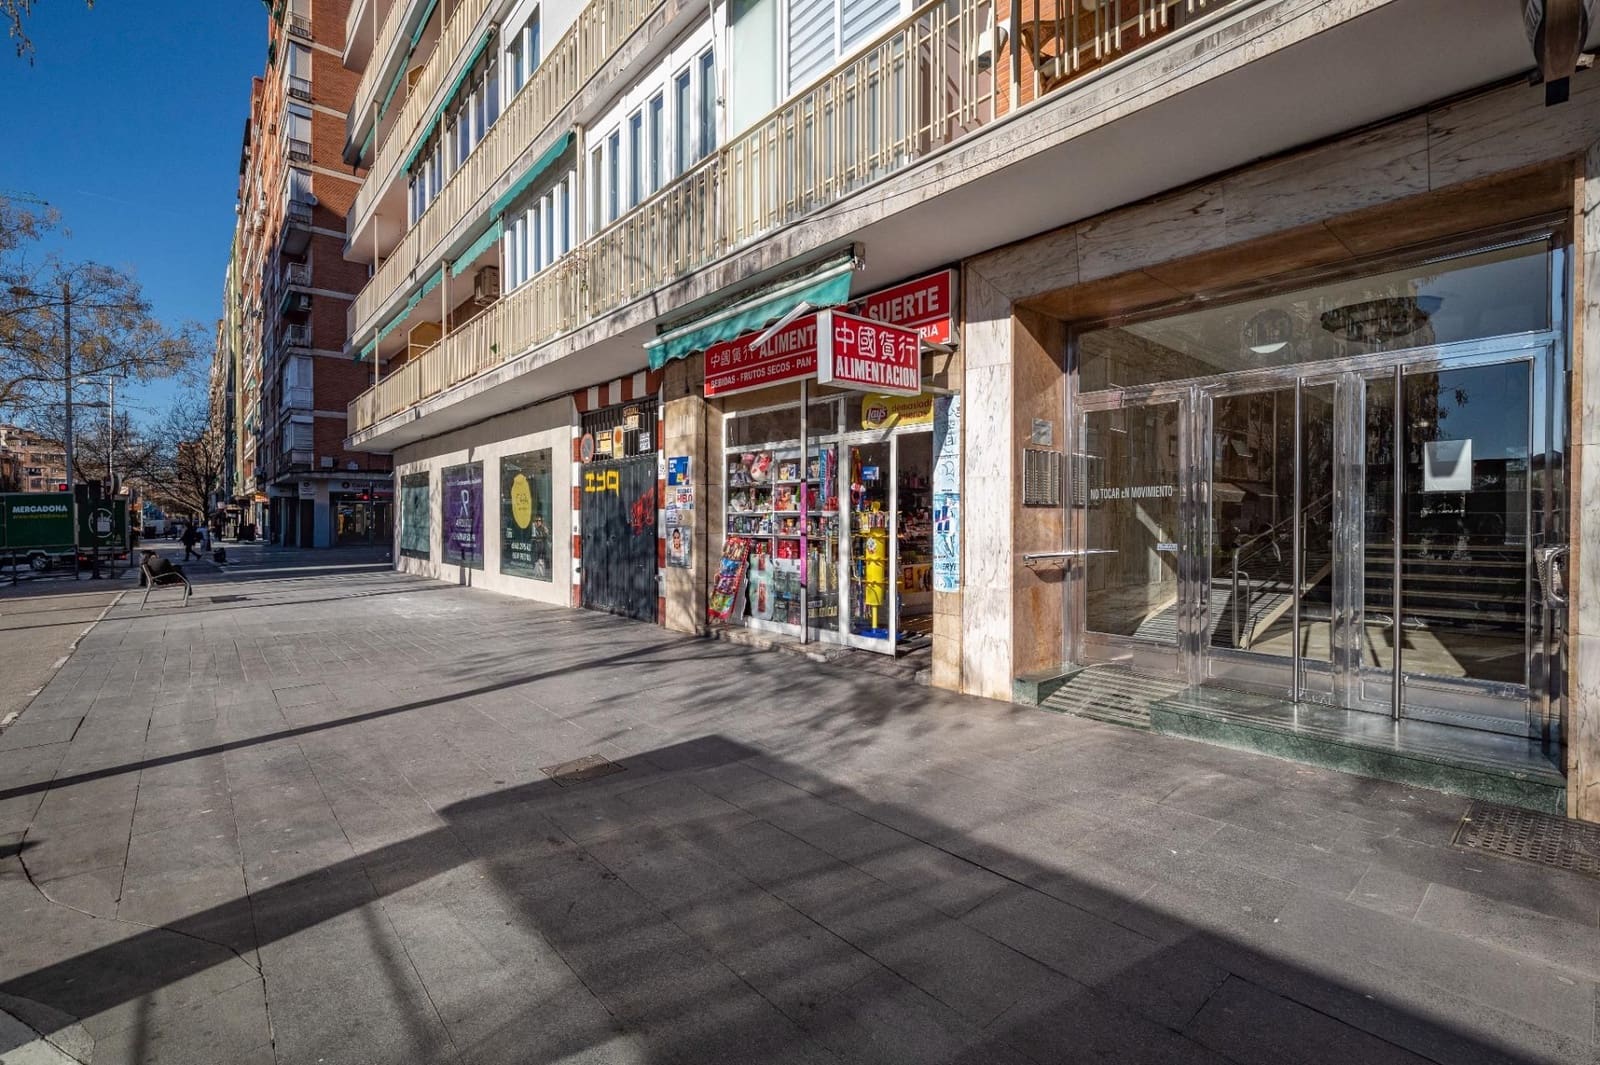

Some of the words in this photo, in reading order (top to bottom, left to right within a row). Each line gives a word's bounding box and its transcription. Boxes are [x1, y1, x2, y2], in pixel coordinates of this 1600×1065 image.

[868, 285, 940, 323] SUERTE
[758, 323, 817, 360] ALIMENT
[835, 320, 917, 366] 中國貨行
[917, 323, 939, 339] RIA
[710, 375, 736, 390] BEBIDAS
[740, 369, 766, 382] FRUTOS
[767, 362, 791, 376] SECOS
[796, 356, 812, 369] PAN
[835, 355, 917, 389] ALIMENTACION
[12, 505, 68, 514] MERCADONA
[1090, 489, 1100, 500] NO
[1101, 488, 1120, 498] TOCAR
[1131, 485, 1173, 498] MOVIMIENTO
